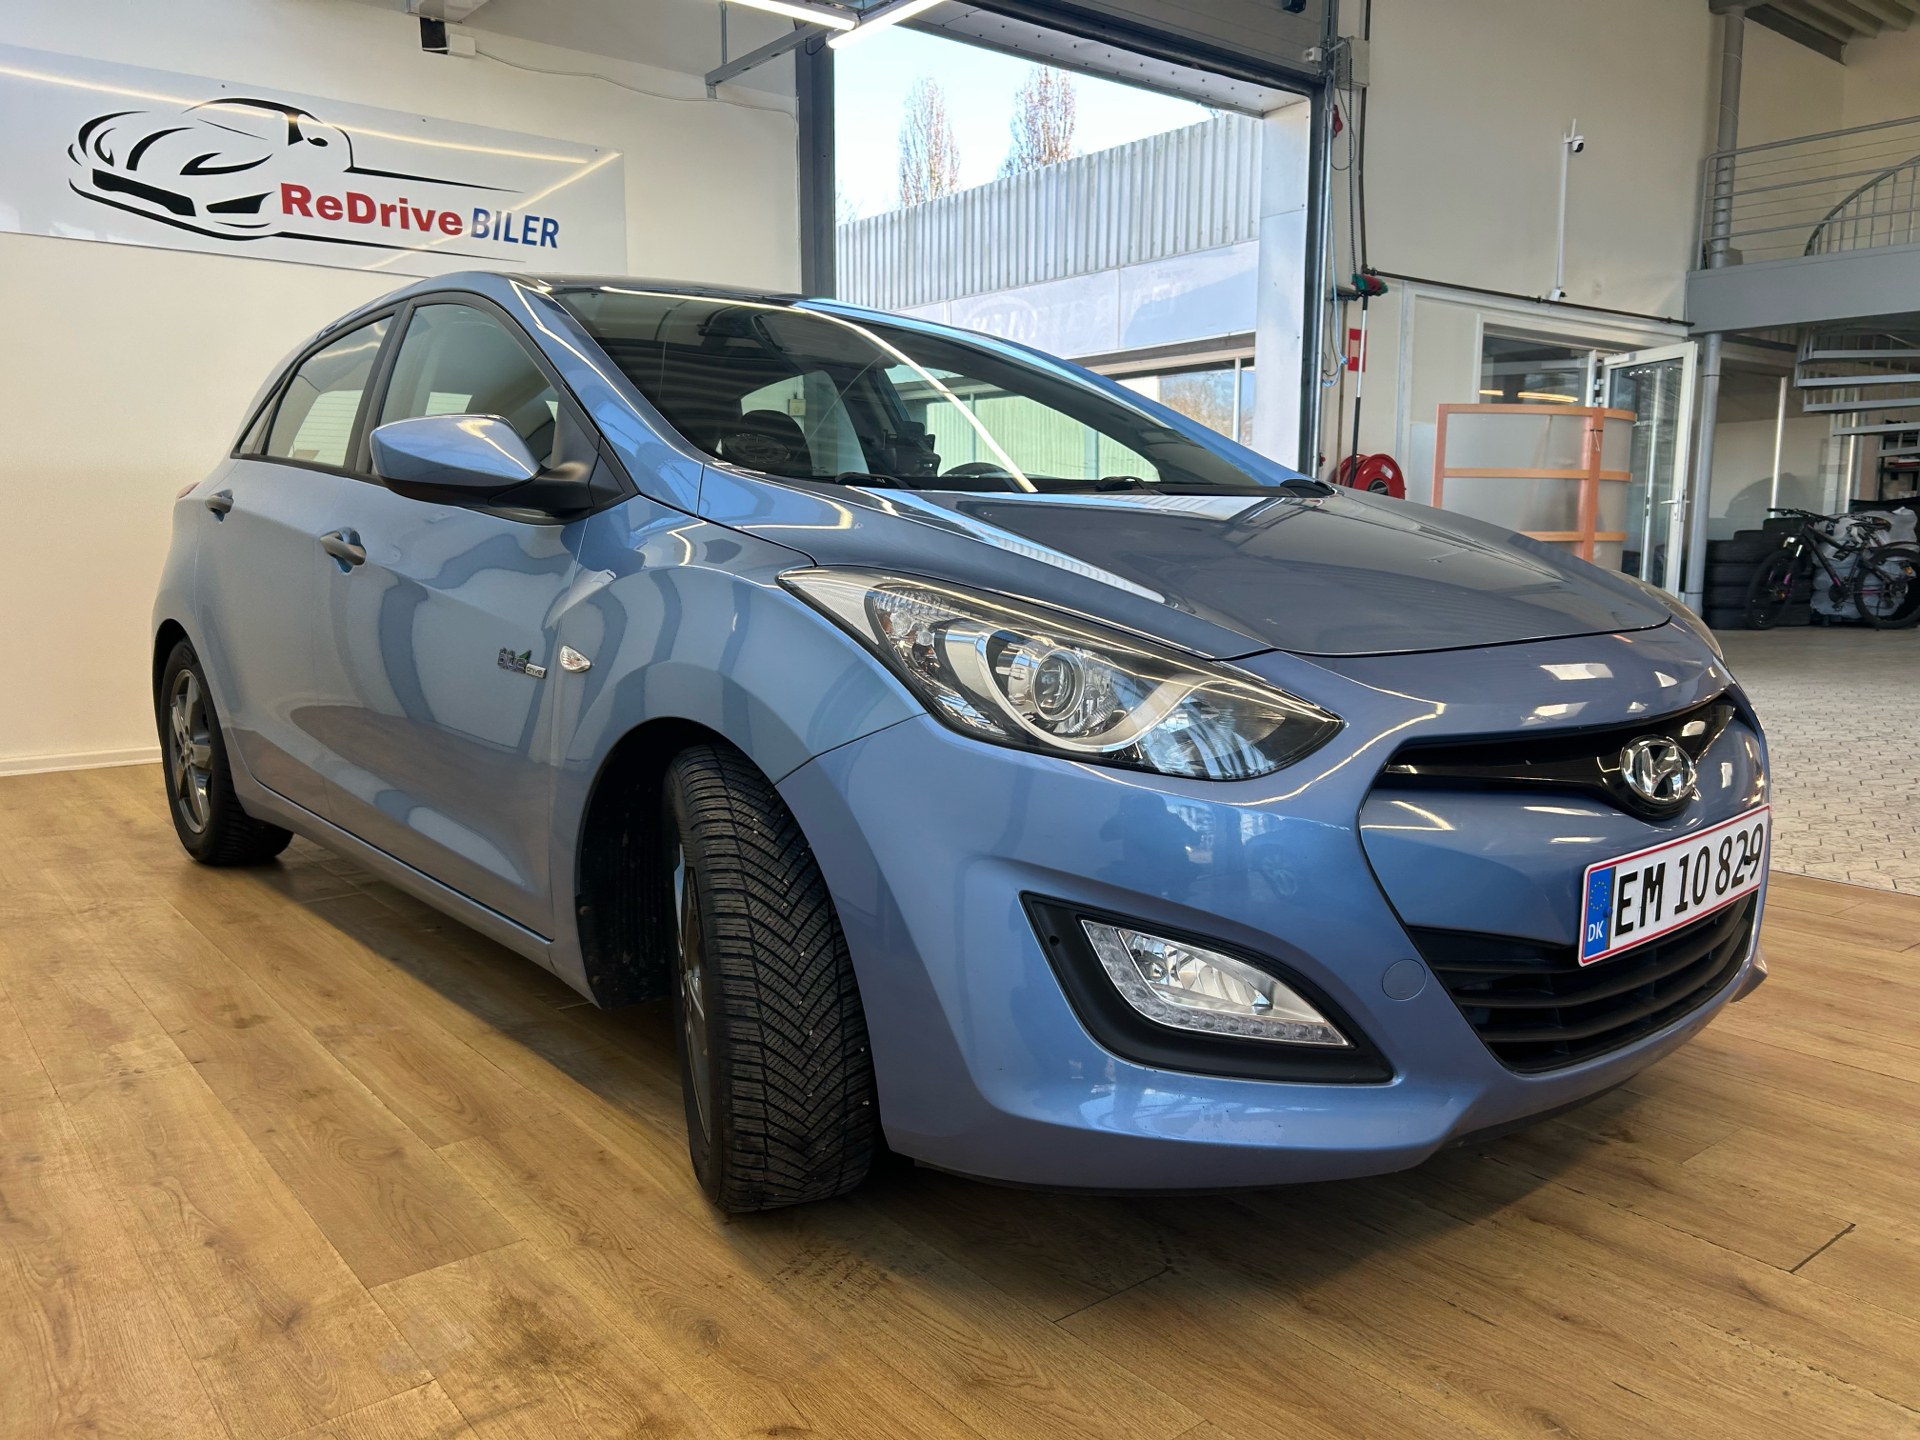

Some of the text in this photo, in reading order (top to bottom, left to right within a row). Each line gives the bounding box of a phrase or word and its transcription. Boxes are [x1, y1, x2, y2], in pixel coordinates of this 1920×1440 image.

[281, 182, 560, 249] ReDrive BILER
[1587, 922, 1604, 943] DK
[1615, 862, 1666, 936] EM
